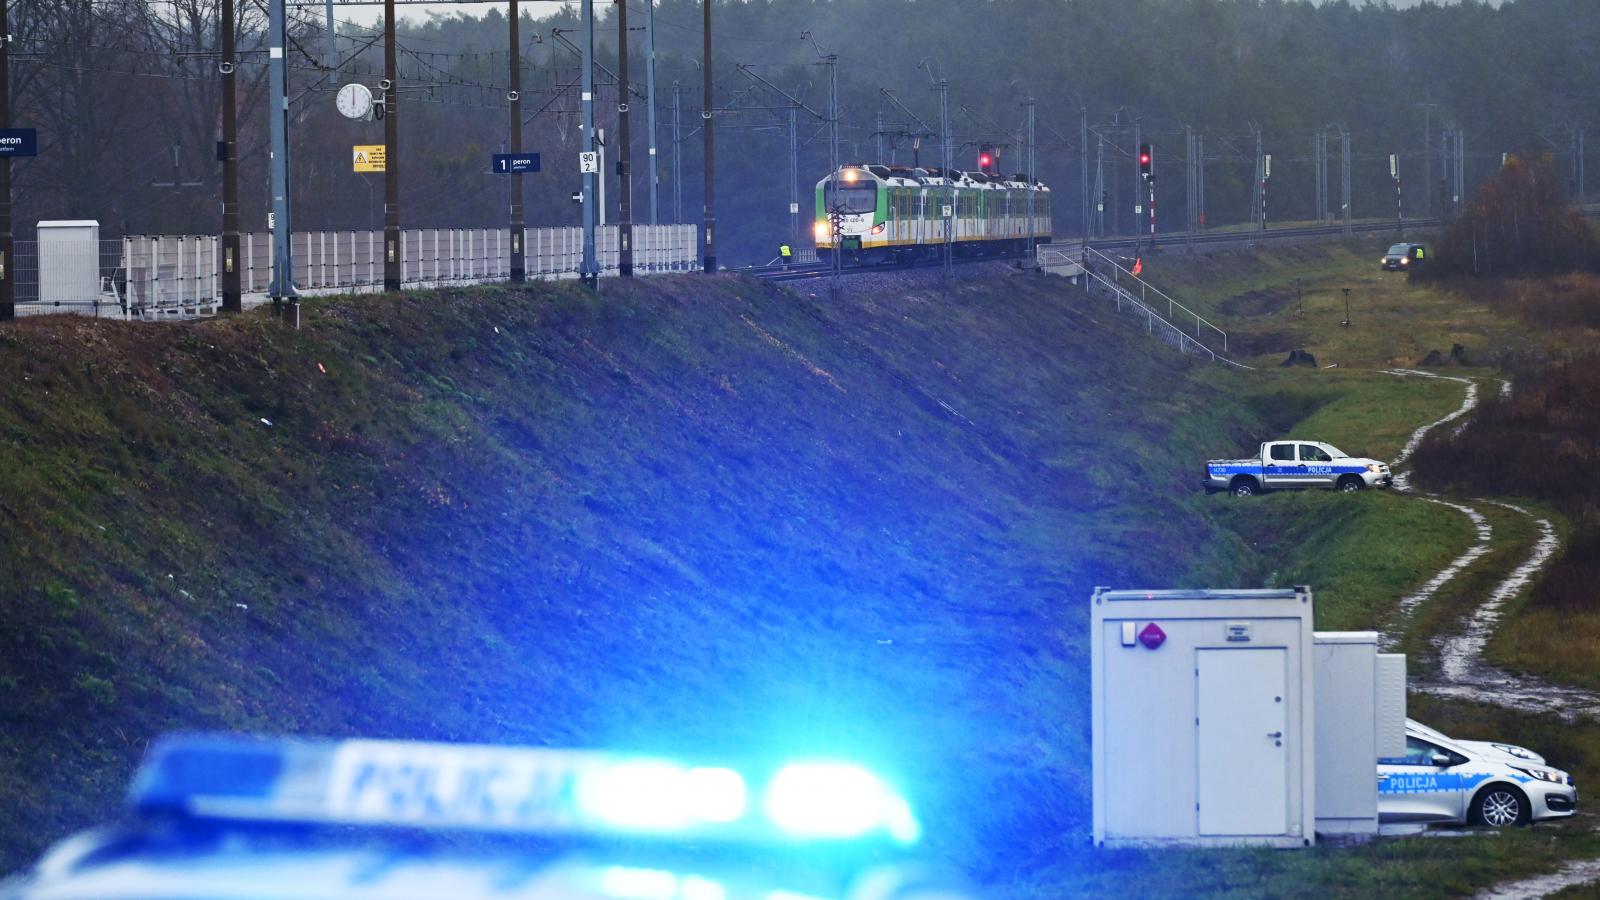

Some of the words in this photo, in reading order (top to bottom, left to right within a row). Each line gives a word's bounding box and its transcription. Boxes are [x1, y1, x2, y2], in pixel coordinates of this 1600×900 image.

[583, 153, 594, 162] 90
[500, 159, 506, 170] 1
[585, 163, 591, 171] 2
[1390, 776, 1438, 789] POLICJA
